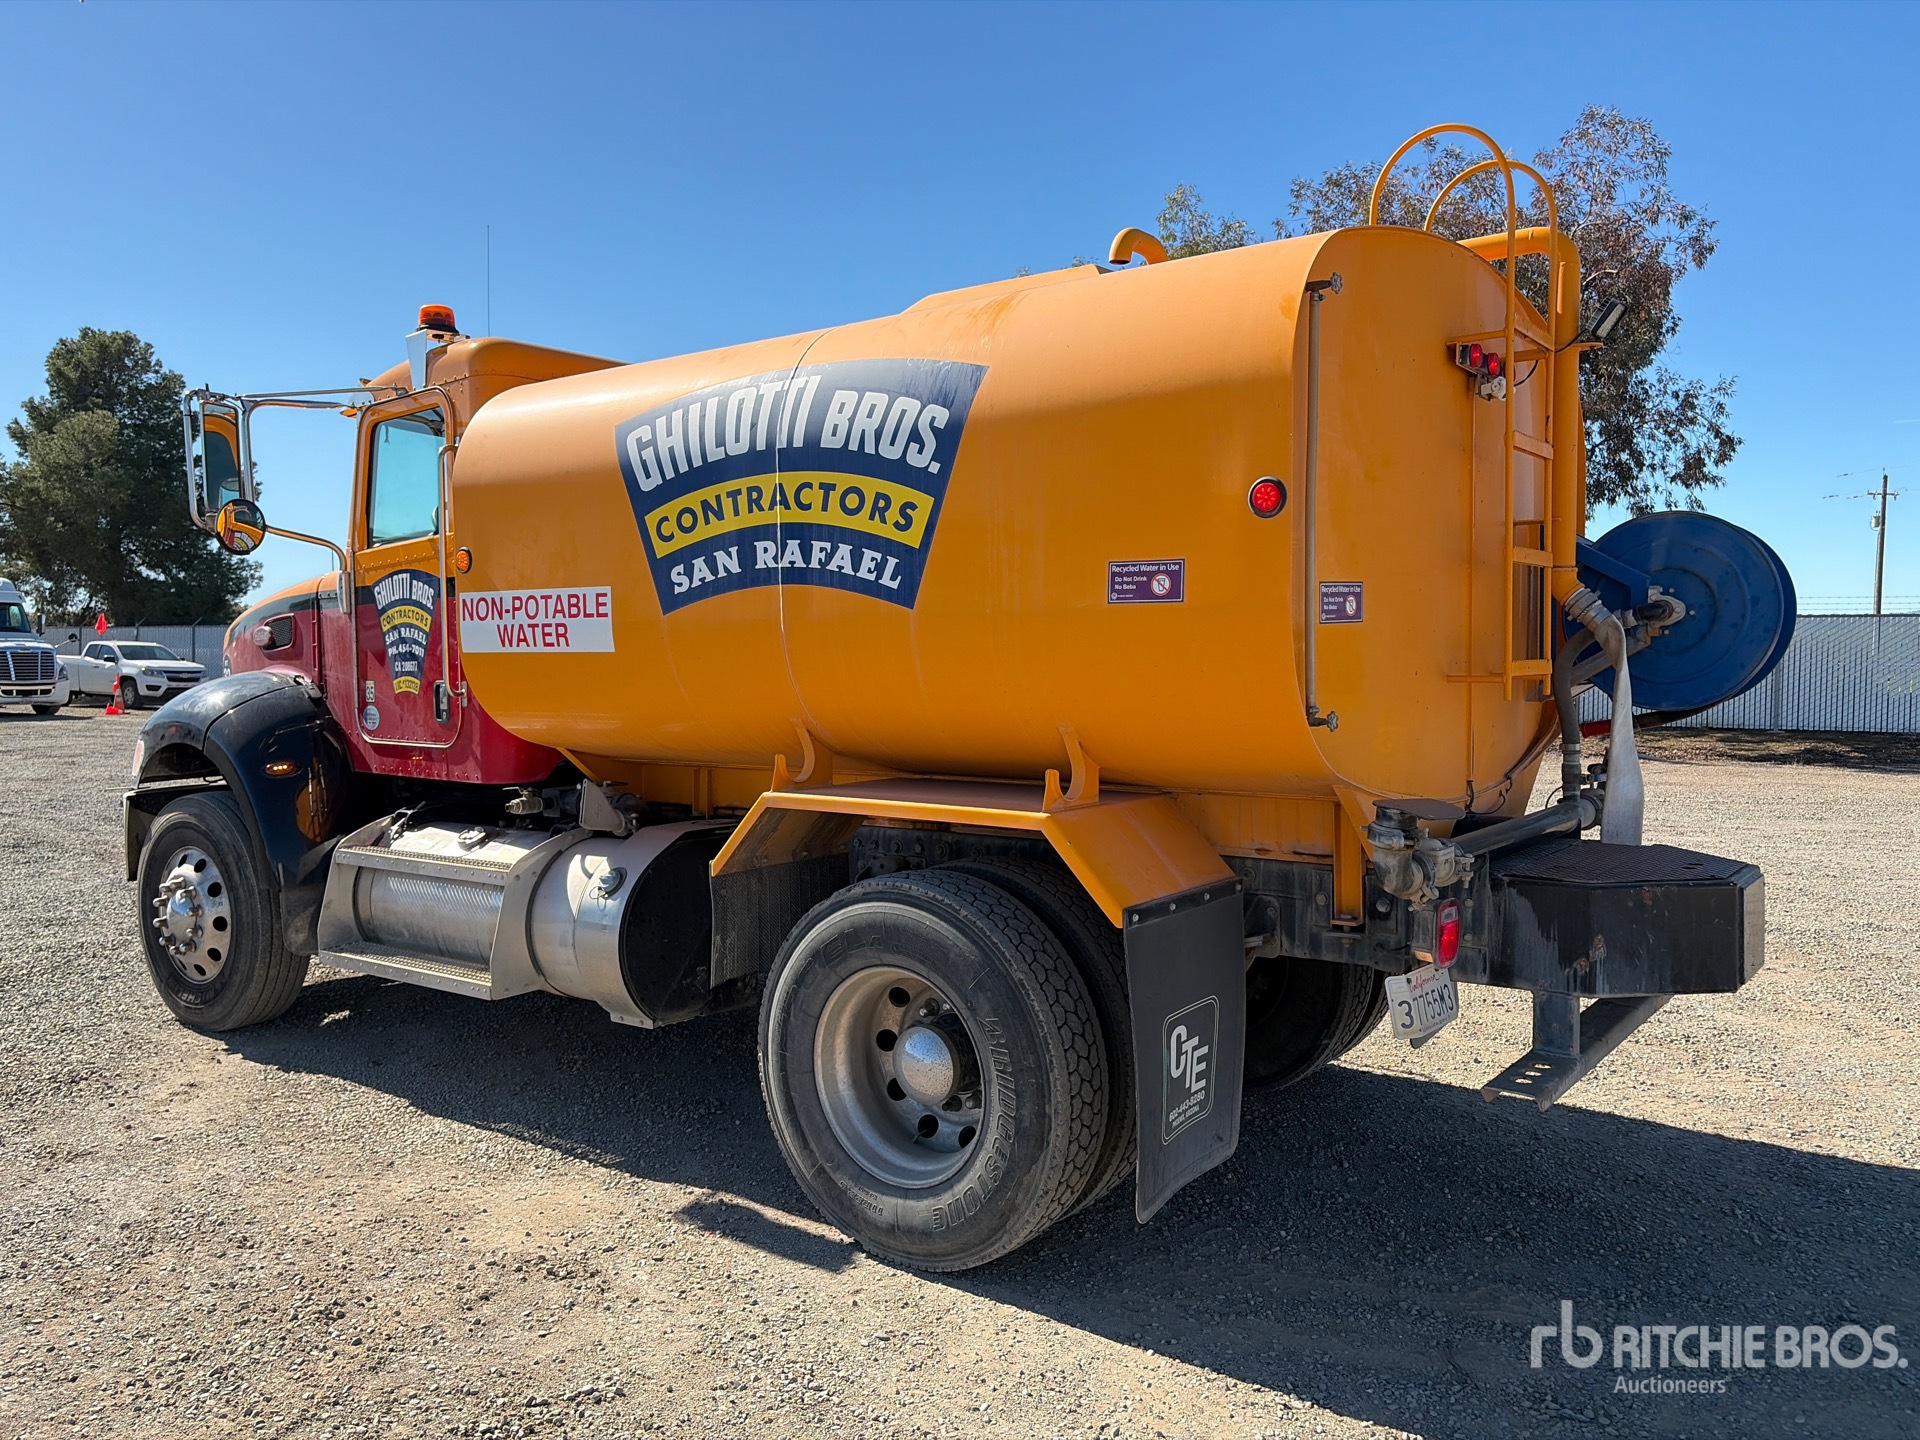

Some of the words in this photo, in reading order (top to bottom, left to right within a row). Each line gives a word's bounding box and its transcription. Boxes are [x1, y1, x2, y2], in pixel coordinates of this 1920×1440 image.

[626, 375, 821, 492] GHILOTTI
[820, 389, 950, 474] BROS.
[655, 481, 918, 543] CONTRACTORS
[670, 545, 743, 595] SAN
[755, 539, 903, 590] RAFAEL
[1111, 564, 1139, 574] Recycled
[1140, 564, 1159, 572] Water
[1167, 563, 1180, 571] Use
[373, 573, 410, 610] GHILOTTI
[411, 580, 435, 610] BROS.
[1321, 585, 1338, 594] Recycled
[382, 608, 429, 628] CONTRACTORS
[461, 592, 609, 622] NON-POTABLE
[385, 628, 399, 645] SAN
[400, 627, 427, 646] RAFAEL
[496, 622, 571, 649] WATER
[1397, 983, 1454, 1030] 37755M3
[1170, 1024, 1209, 1094] CTE
